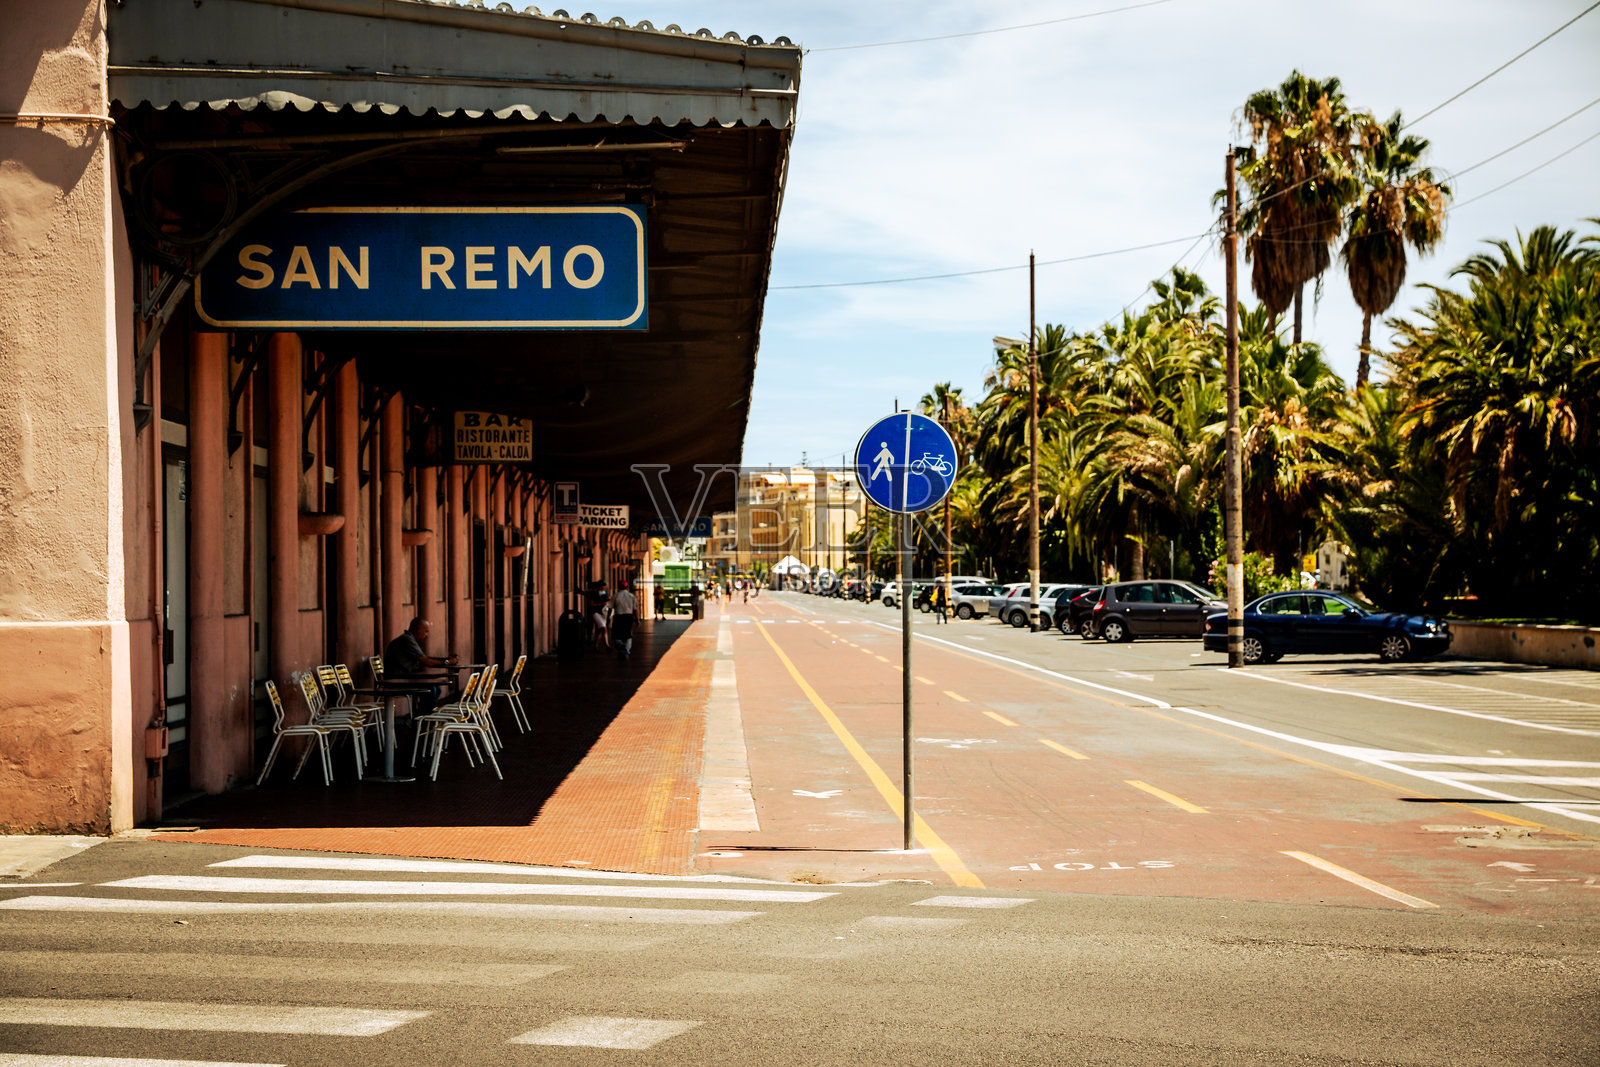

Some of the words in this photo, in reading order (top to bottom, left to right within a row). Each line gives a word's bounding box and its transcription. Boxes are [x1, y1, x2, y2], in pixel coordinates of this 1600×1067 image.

[236, 244, 370, 290] SAN
[420, 244, 605, 290] REMO
[463, 413, 523, 427] BAR
[457, 429, 530, 443] RISTORANTE
[457, 445, 492, 458] TAVOLA
[499, 445, 530, 459] CALDA
[581, 507, 622, 516] TICKET
[673, 522, 707, 532] RMO
[1008, 860, 1175, 871] STOP
